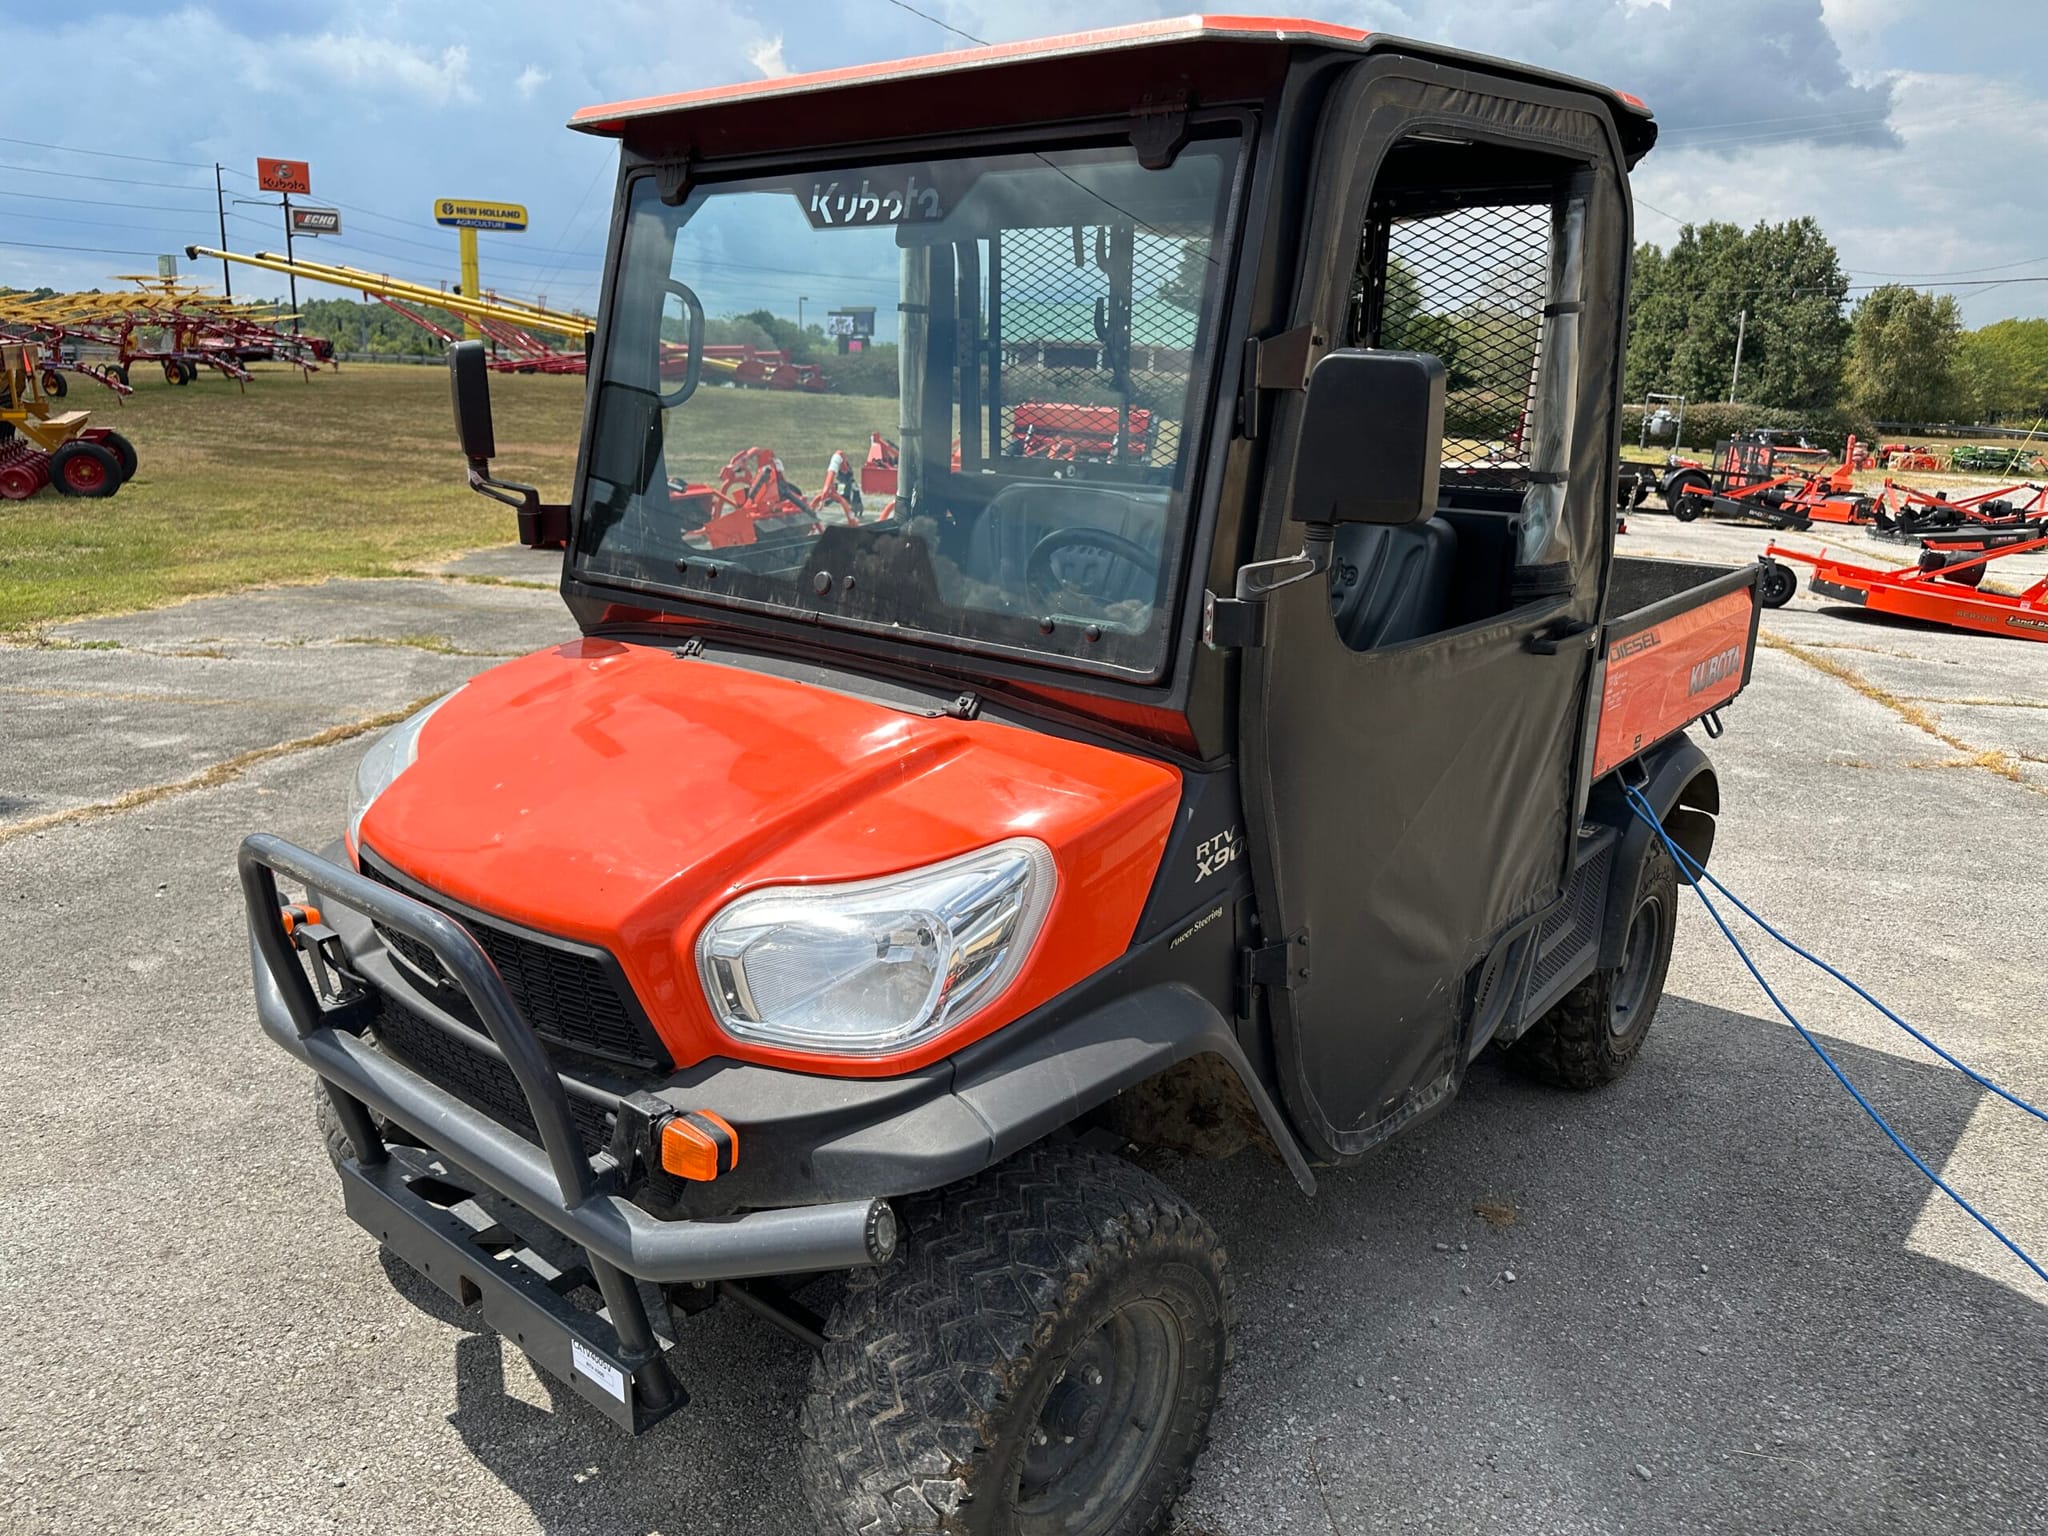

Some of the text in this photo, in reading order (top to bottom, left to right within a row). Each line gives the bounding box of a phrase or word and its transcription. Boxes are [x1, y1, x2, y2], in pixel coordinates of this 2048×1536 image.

[263, 177, 306, 190] Kubota
[456, 206, 520, 218] NEW HOLLAND
[810, 176, 940, 223] Kubota
[304, 214, 336, 225] ECHO
[456, 219, 506, 229] AGRICULTURE
[1609, 632, 1661, 663] DIESEL
[1688, 645, 1740, 696] KUBOTA
[1196, 825, 1235, 860] RTV
[1193, 906, 1223, 932] Steering
